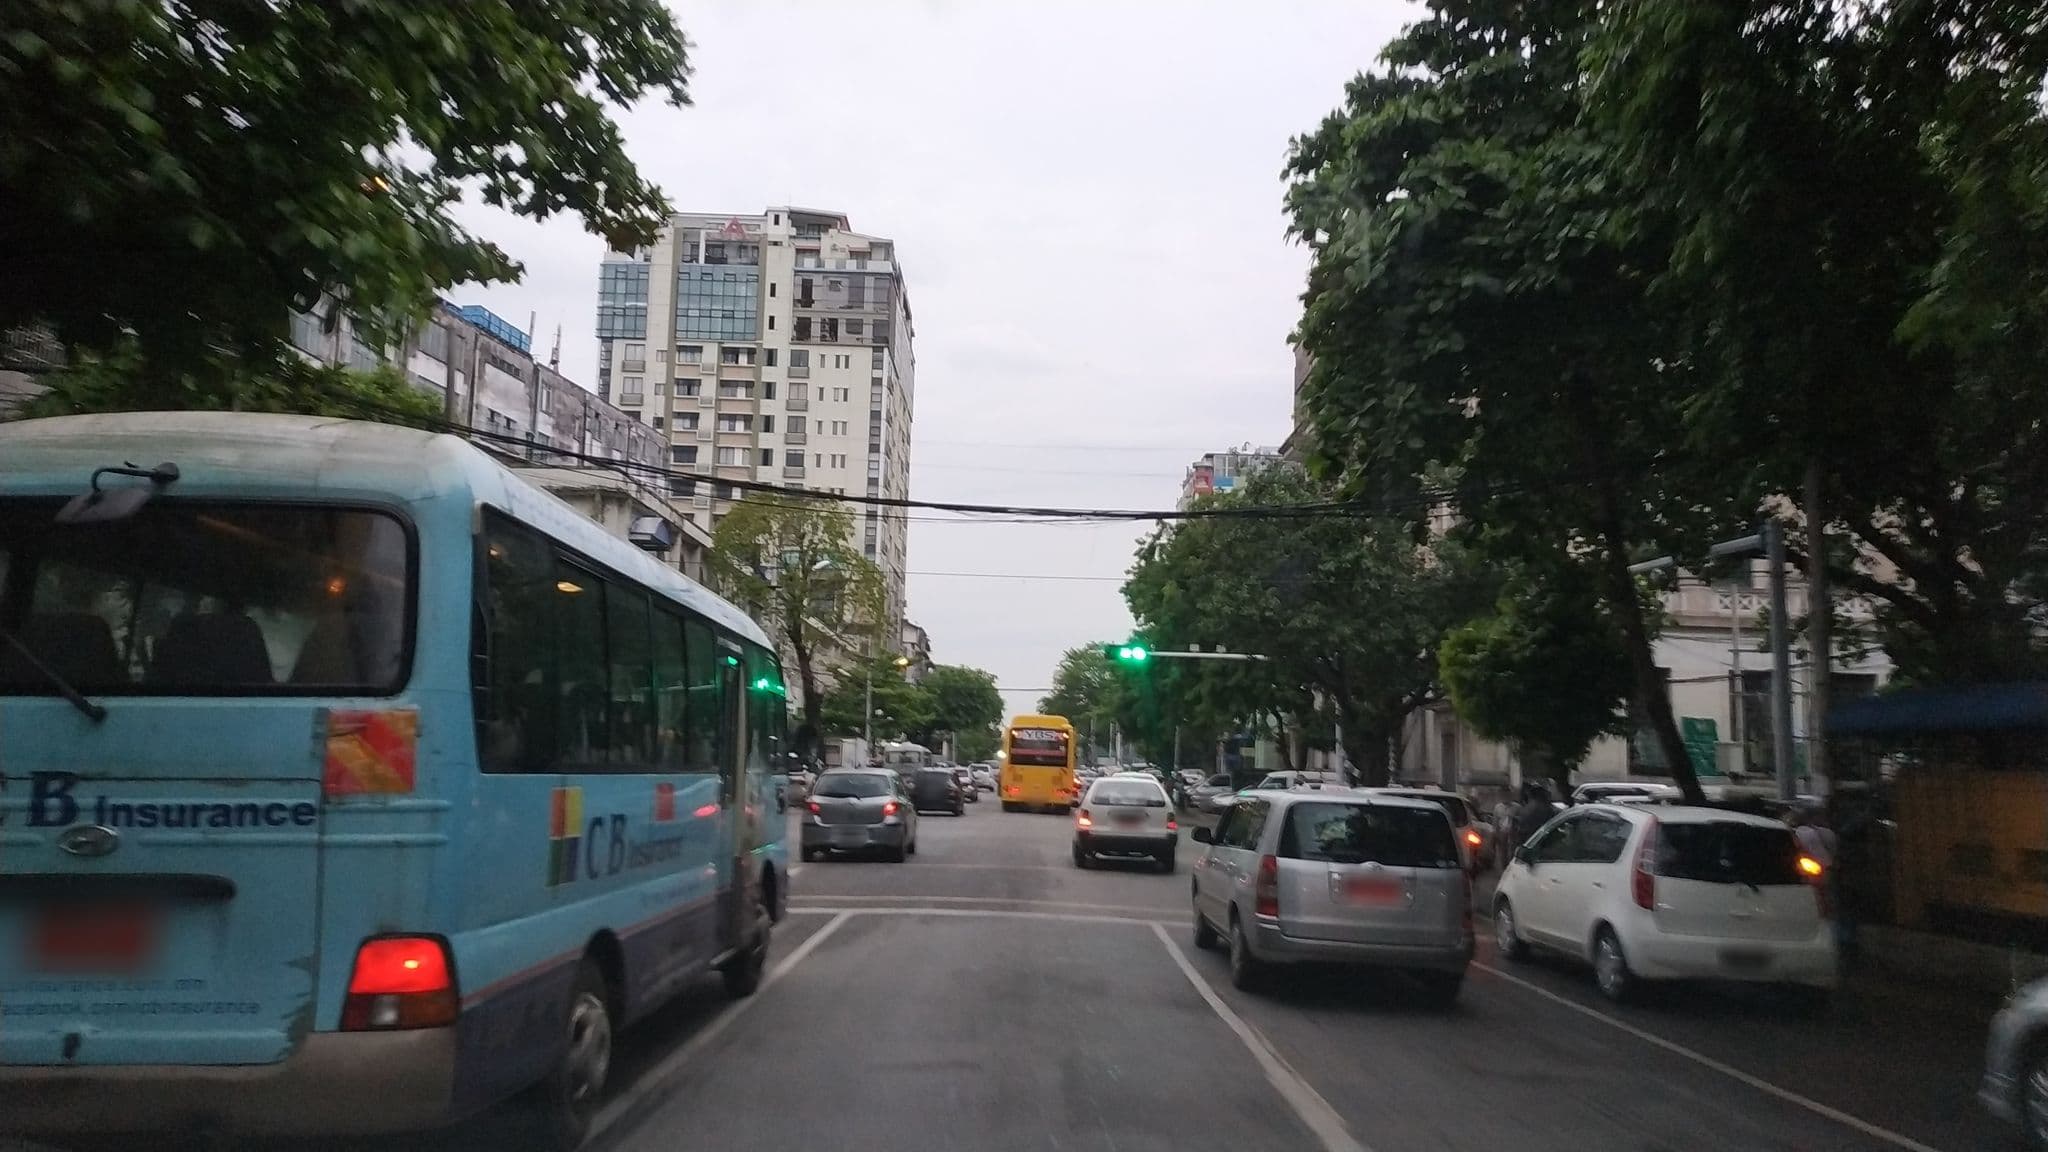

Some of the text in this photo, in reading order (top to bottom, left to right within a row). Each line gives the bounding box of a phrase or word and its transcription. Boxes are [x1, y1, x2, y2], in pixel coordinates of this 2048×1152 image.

[1023, 730, 1055, 739] YBS
[95, 795, 317, 828] Insurance
[586, 813, 628, 880] CB
